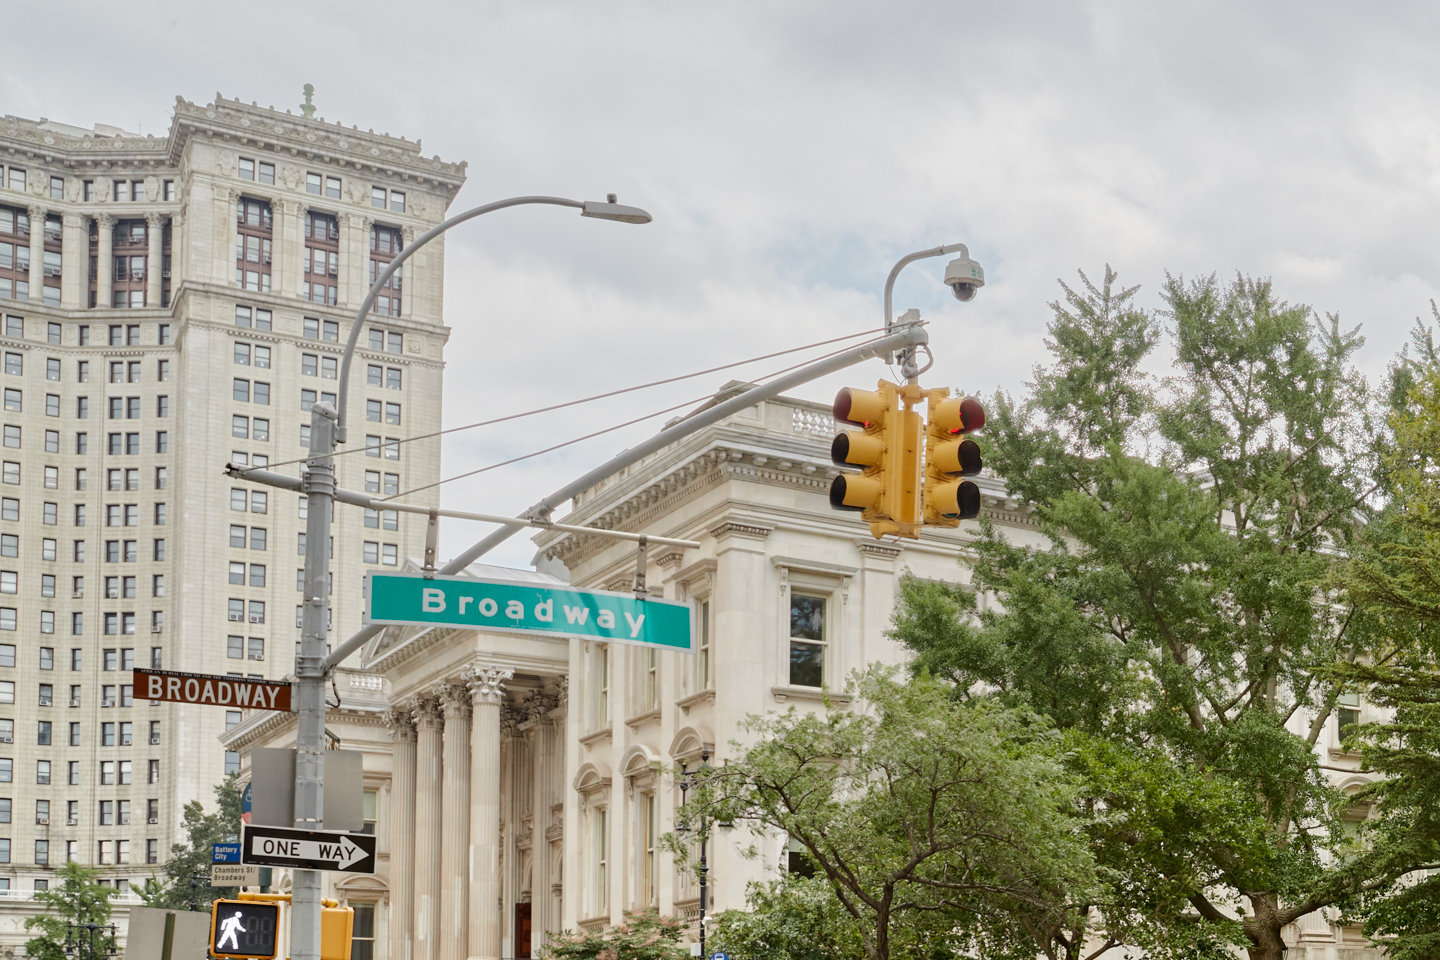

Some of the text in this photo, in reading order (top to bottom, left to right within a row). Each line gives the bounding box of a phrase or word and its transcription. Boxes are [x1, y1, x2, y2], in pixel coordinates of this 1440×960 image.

[421, 587, 646, 638] Broadway
[148, 675, 280, 708] BROADWAY
[214, 846, 238, 854] Battery
[262, 839, 357, 861] ONE WAY
[214, 853, 227, 861] City
[214, 866, 246, 874] Chambers
[213, 874, 246, 882] Broadway
